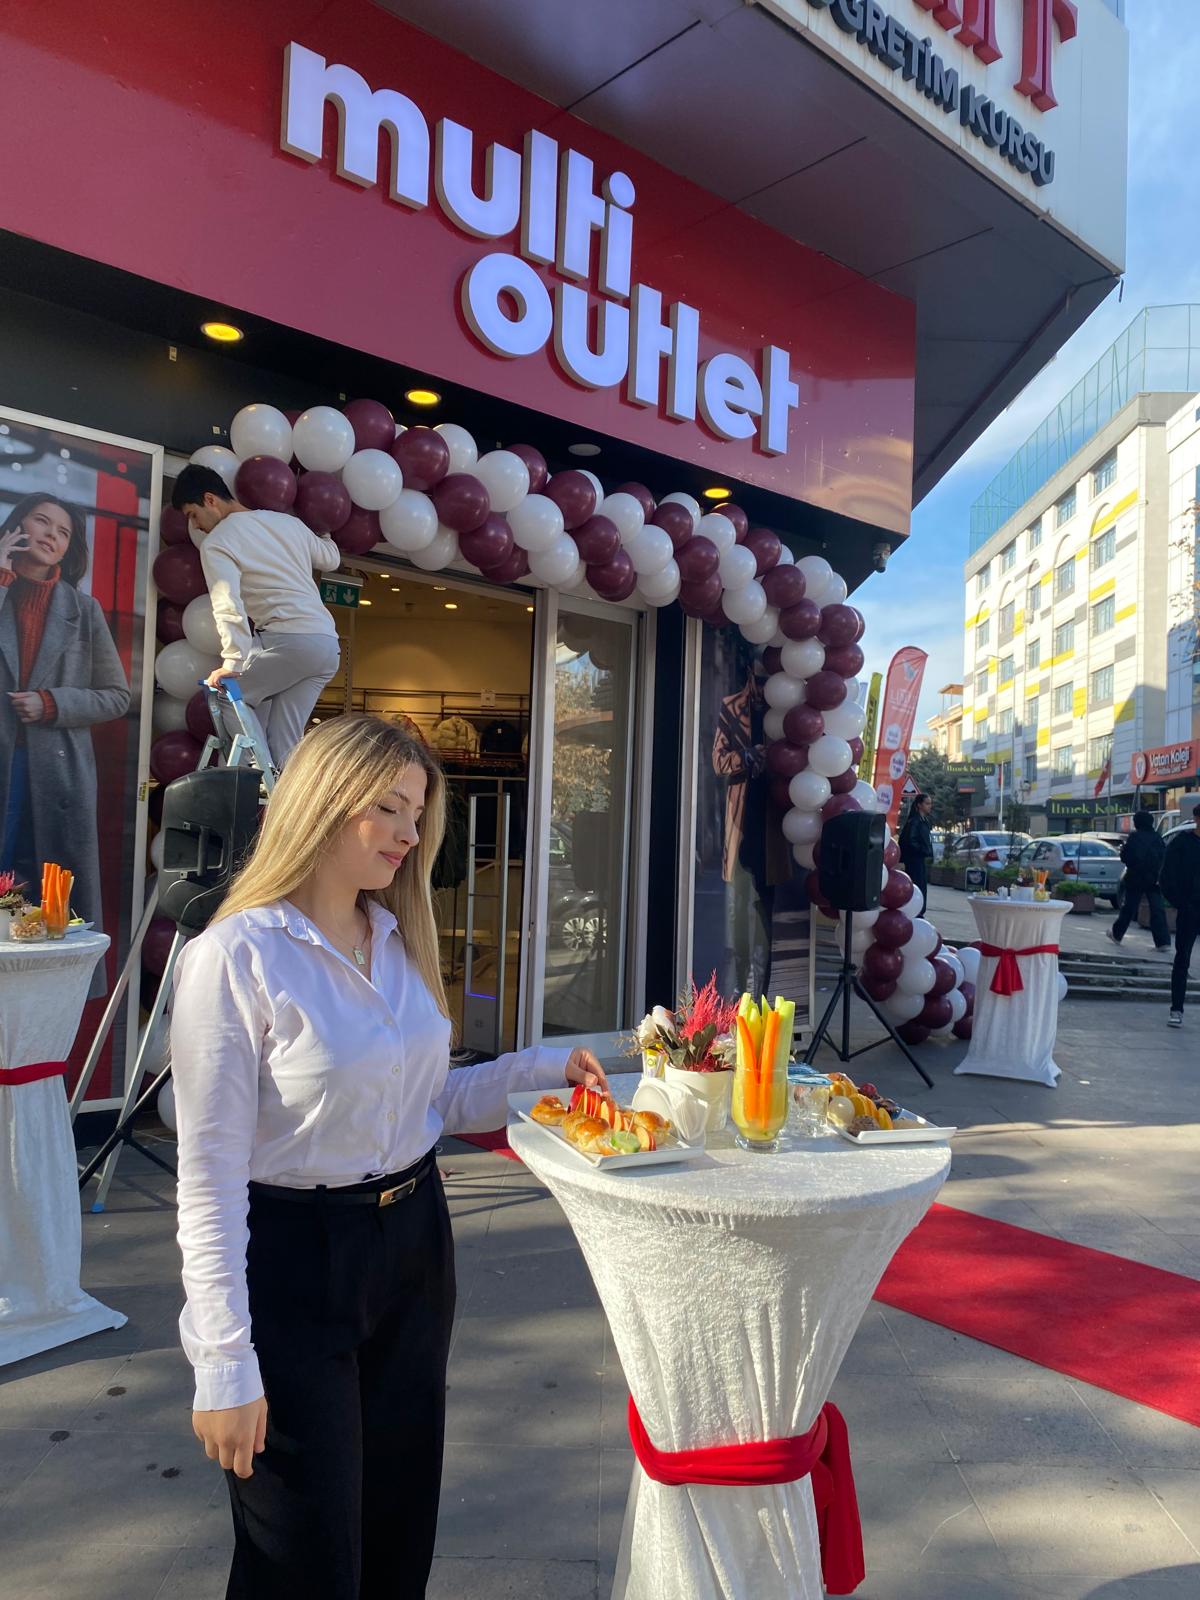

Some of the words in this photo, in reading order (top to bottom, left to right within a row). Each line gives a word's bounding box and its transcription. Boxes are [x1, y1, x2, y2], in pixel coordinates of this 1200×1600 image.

[280, 40, 636, 299] multi
[960, 84, 1055, 187] KURSU
[462, 252, 800, 456] outlet
